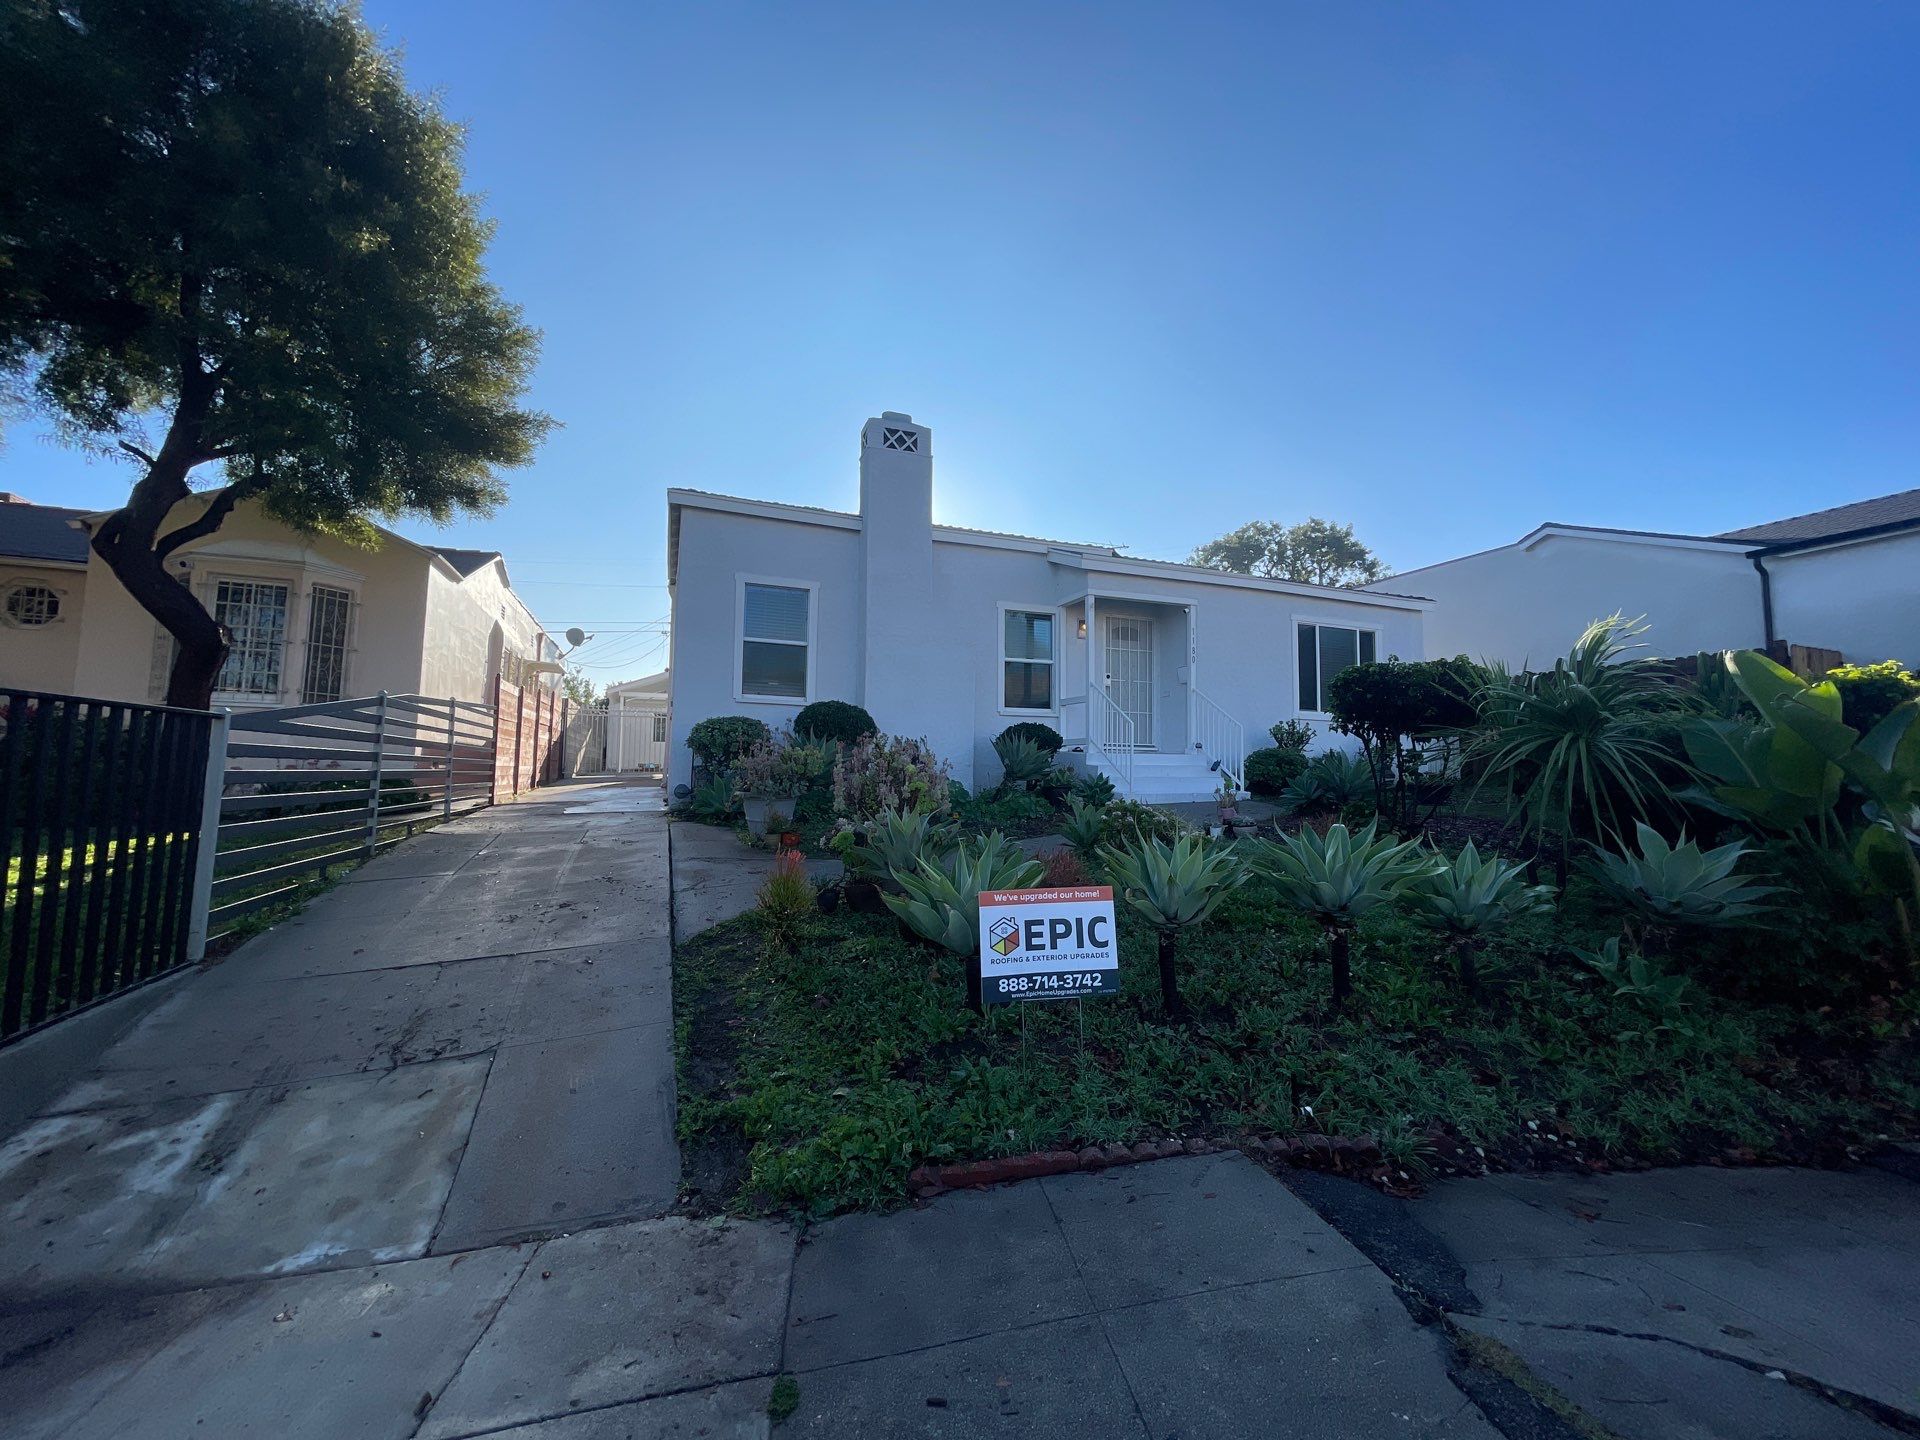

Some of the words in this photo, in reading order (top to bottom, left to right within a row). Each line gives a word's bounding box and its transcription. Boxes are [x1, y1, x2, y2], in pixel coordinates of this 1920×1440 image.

[994, 894, 1018, 902] We've
[1020, 892, 1057, 902] upgraded
[1075, 890, 1100, 898] home!
[1024, 916, 1109, 951] EPIC
[990, 957, 1023, 965] ROOFING
[1070, 952, 1109, 960] UPGRADES
[998, 973, 1102, 992] 888-714-3742
[1011, 988, 1092, 998] www.EpicHomeUpgrades.com
